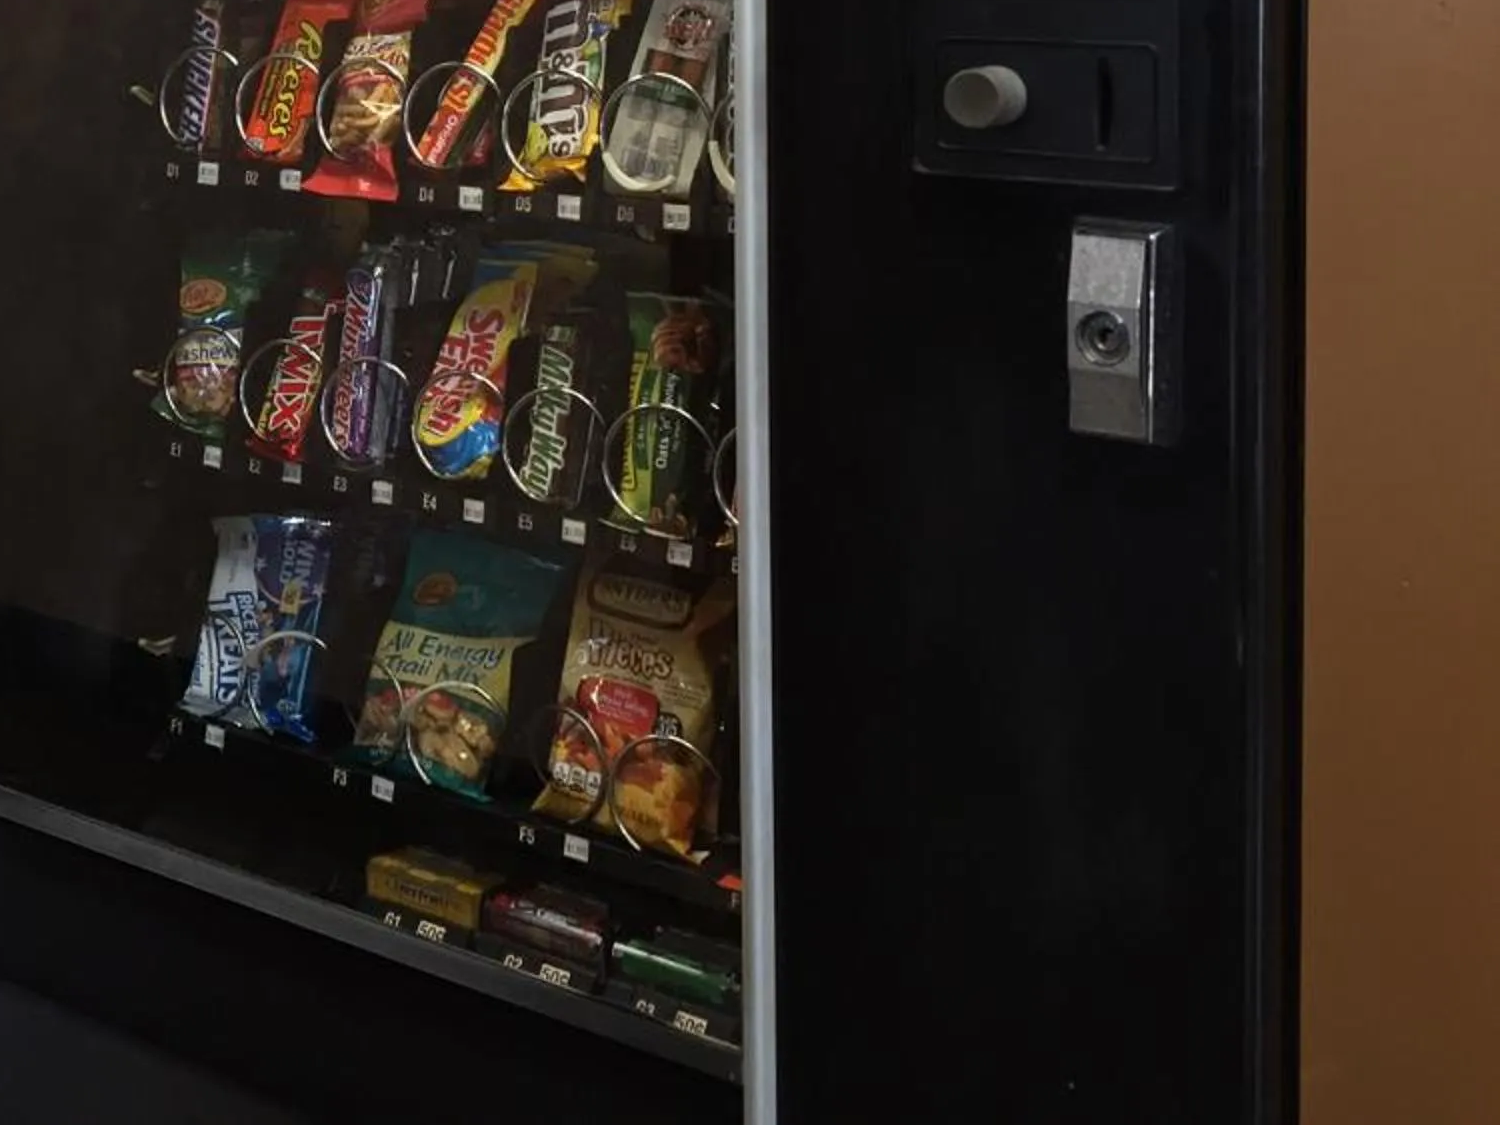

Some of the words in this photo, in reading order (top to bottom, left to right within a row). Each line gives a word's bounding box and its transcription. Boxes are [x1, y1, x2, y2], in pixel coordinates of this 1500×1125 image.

[179, 7, 221, 152] SNICKERS
[269, 21, 324, 138] Reese's
[244, 170, 260, 187] D2
[418, 187, 435, 205] D4
[515, 196, 532, 213] D5
[617, 206, 635, 223] D6
[269, 316, 328, 432] TWIX
[170, 442, 182, 458] E1
[655, 436, 671, 470] Oats
[519, 425, 568, 502] Way
[333, 475, 347, 492] E3
[237, 591, 257, 629] RICE
[207, 593, 242, 705] TREATS
[385, 629, 415, 652] All
[418, 632, 506, 670] Energy
[383, 653, 432, 675] Trail
[333, 768, 347, 786] F3
[519, 825, 536, 845] F5
